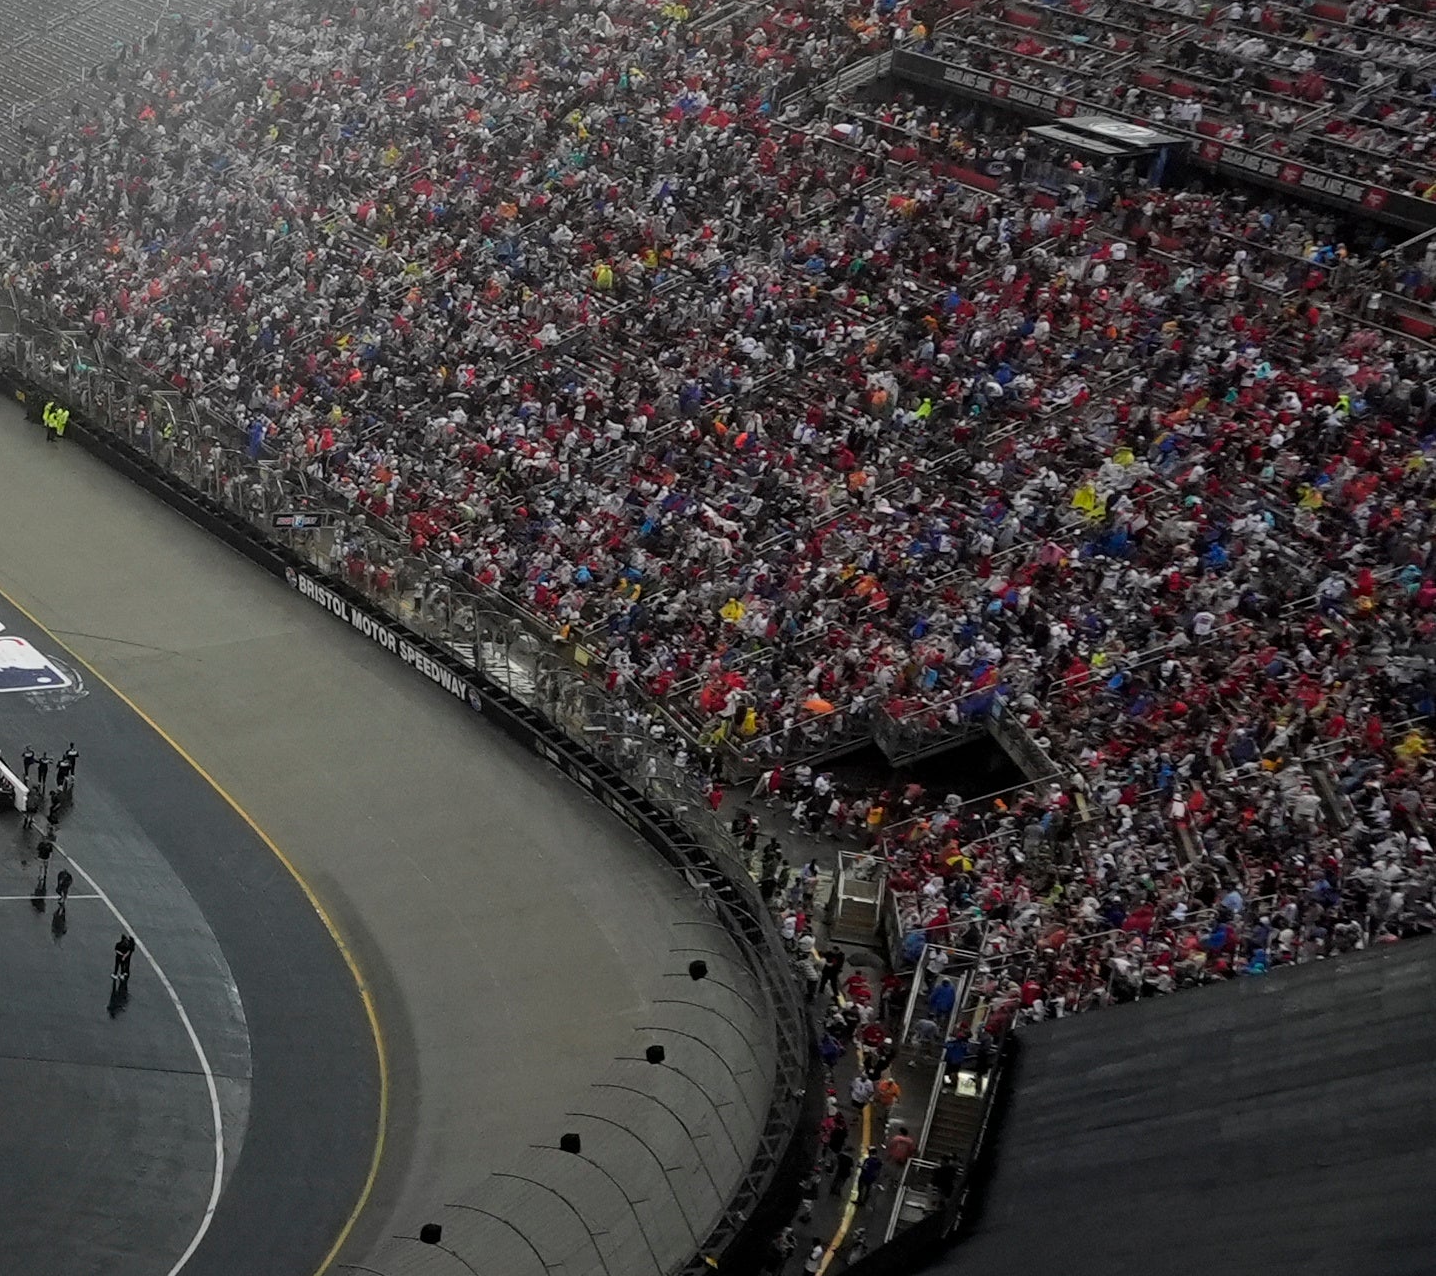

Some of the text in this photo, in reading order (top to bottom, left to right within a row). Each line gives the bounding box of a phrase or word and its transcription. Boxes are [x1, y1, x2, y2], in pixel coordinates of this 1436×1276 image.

[298, 574, 468, 702] BRISTOL MOTOR SPEEDWAY
